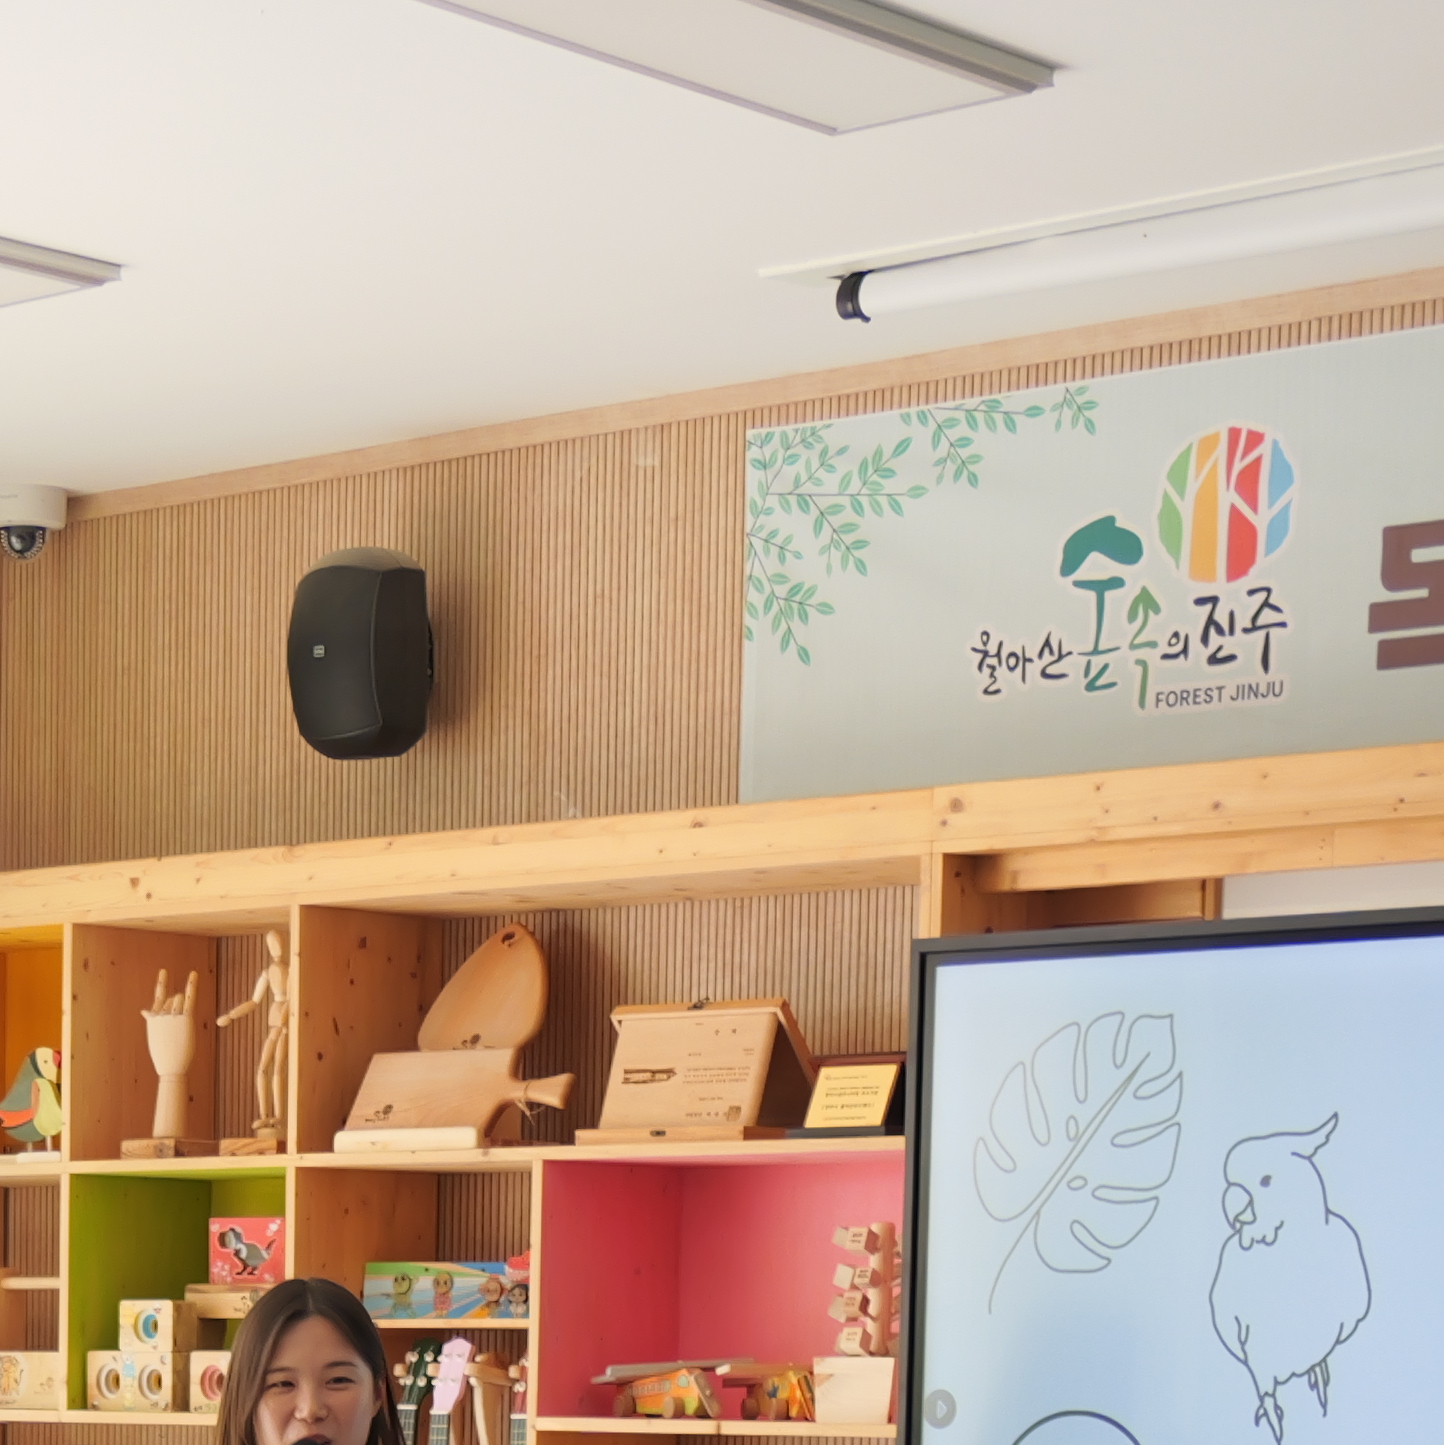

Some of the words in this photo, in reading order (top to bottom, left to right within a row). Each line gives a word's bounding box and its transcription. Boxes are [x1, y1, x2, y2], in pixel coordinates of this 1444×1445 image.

[970, 630, 1073, 695] 월아산
[1193, 585, 1289, 676] 진주
[1154, 686, 1227, 709] FOREST
[1230, 679, 1284, 702] JINJU
